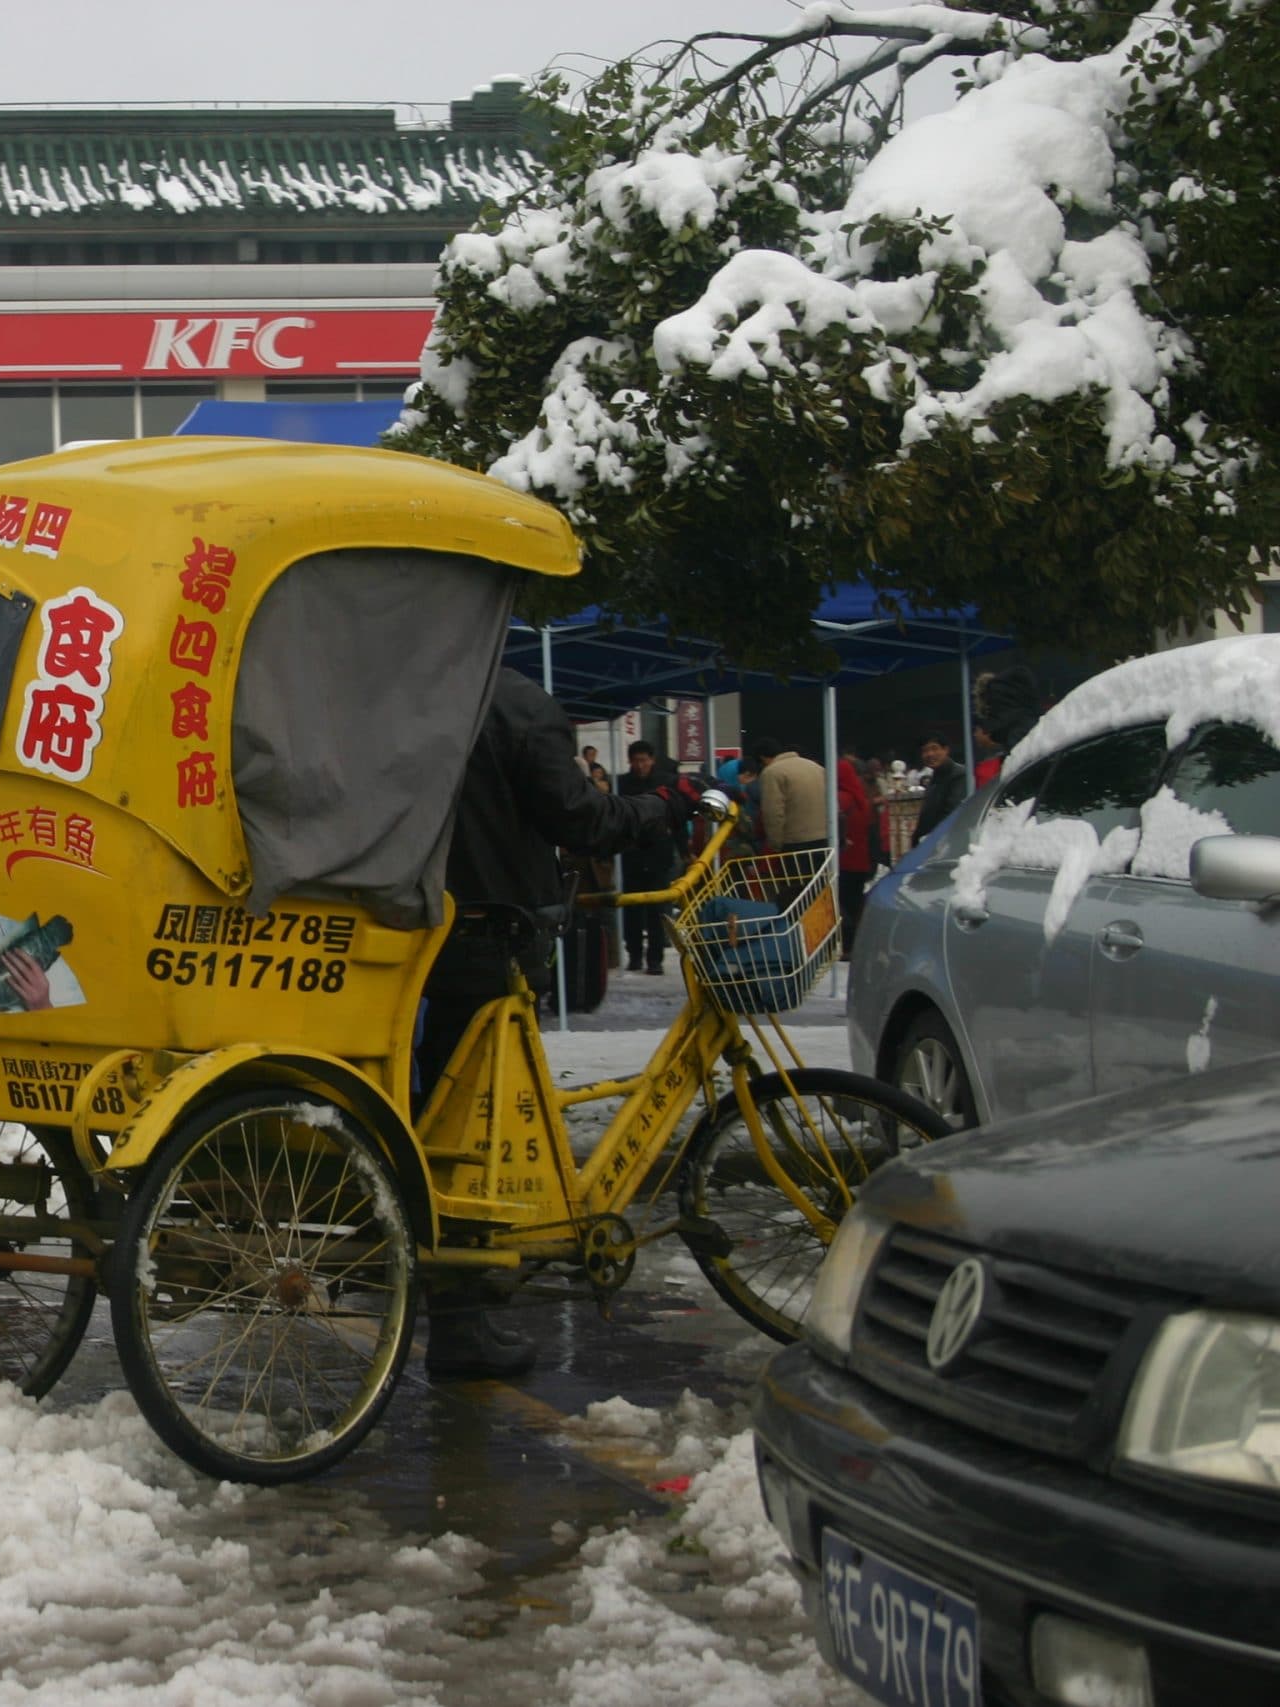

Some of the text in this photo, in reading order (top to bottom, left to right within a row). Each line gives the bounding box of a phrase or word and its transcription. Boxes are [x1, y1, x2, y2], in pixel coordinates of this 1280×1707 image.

[143, 317, 308, 370] KFC
[146, 947, 347, 994] 65117188
[7, 1081, 126, 1115] 6511788
